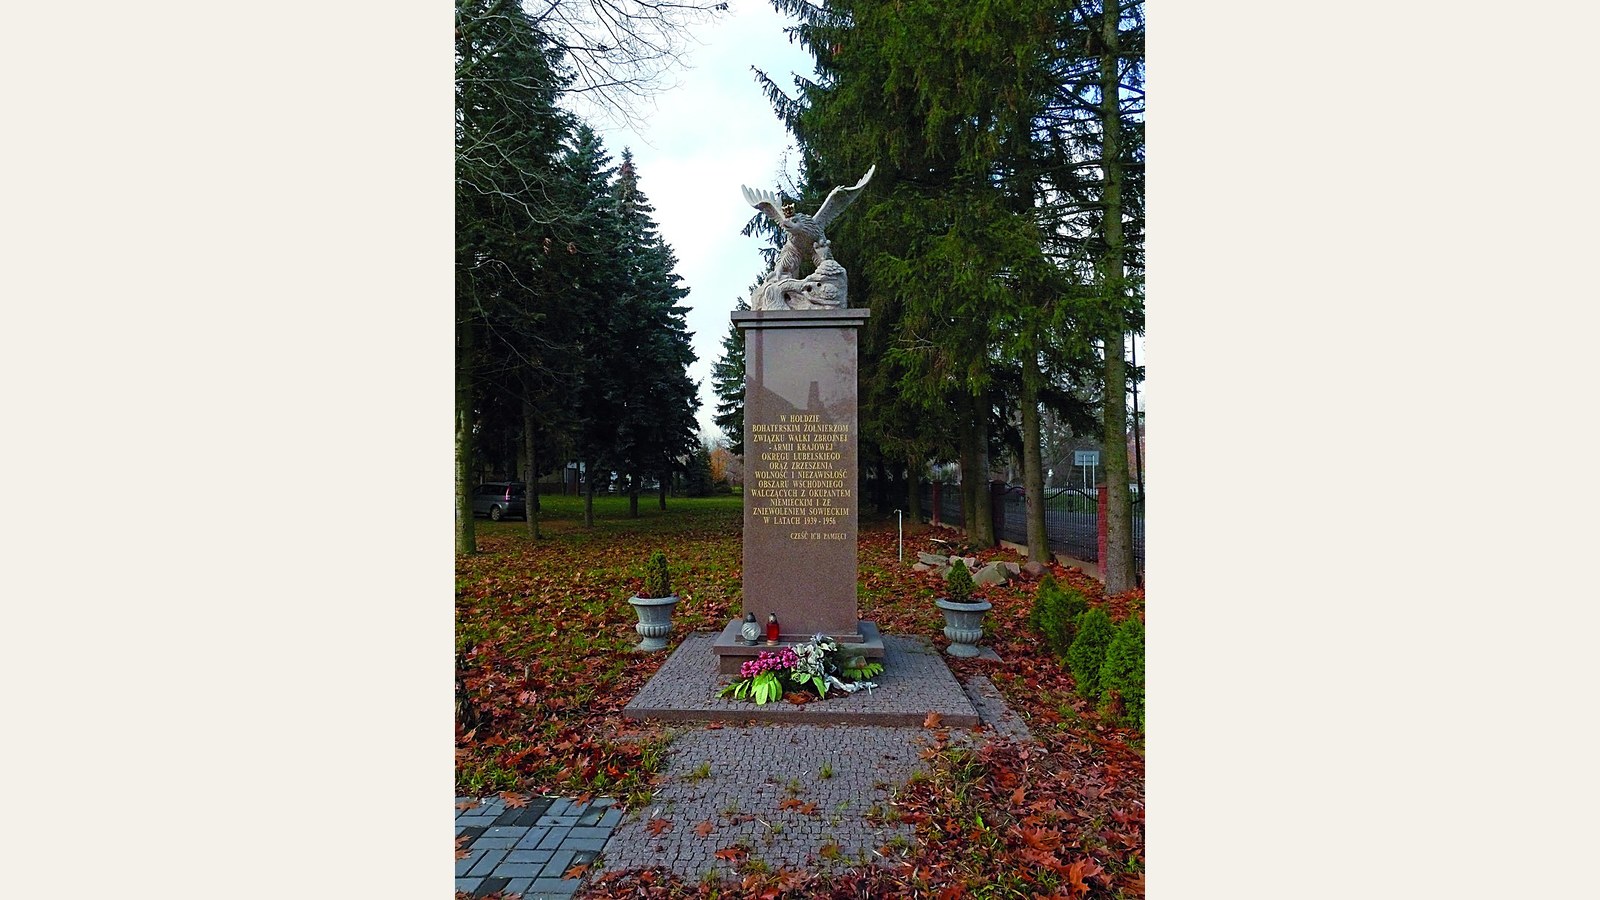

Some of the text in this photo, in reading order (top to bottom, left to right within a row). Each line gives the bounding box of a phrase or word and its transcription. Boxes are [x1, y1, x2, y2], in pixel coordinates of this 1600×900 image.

[780, 414, 787, 422] W
[752, 424, 800, 432] BOHATERSKIM
[754, 434, 847, 444] ZWIĄZKU WALKI ZBROJNEJ
[762, 452, 789, 462] OKRĘGU
[755, 469, 787, 478] WOLNOŚĆ
[751, 490, 797, 499] WALCZĄCYCH
[791, 531, 808, 540] CZEŚĆ
[824, 532, 846, 541] PAMIĘCI
